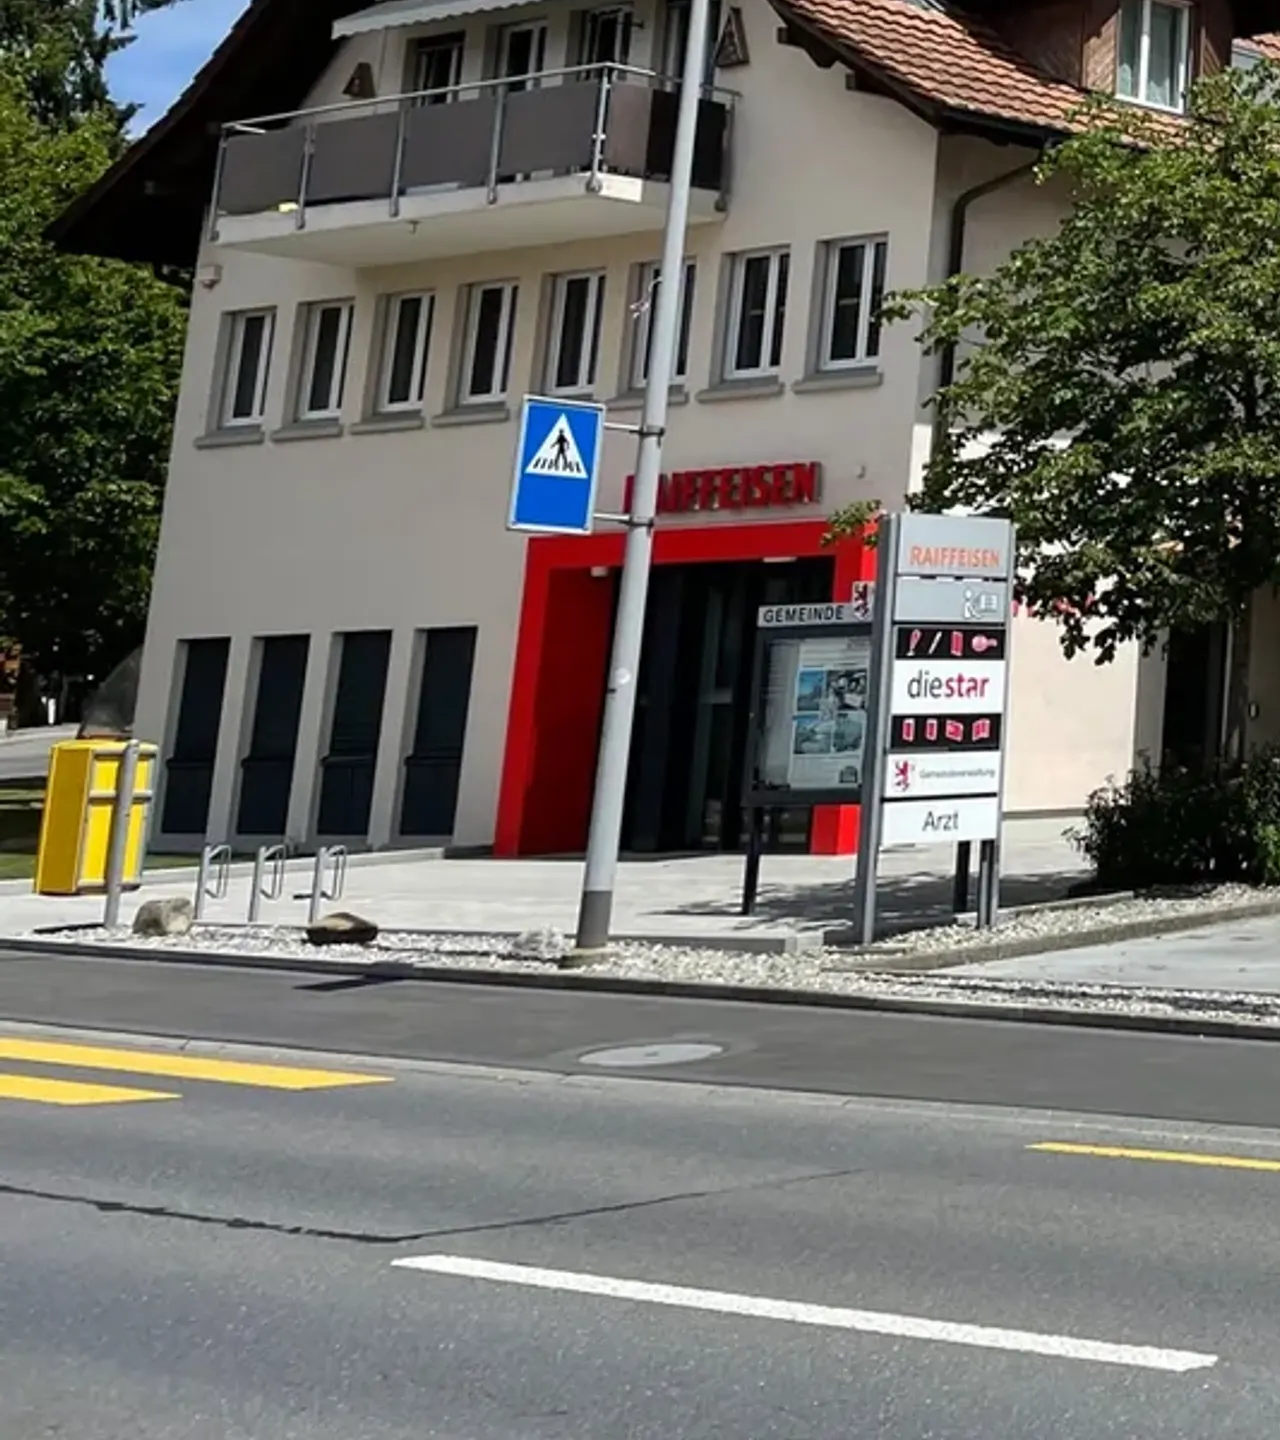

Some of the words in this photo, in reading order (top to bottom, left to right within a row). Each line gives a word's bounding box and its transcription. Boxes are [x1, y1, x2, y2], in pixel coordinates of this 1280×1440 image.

[910, 546, 999, 568] RAIFFEISEN
[763, 604, 845, 623] GEMEINDE
[907, 669, 990, 698] diestar
[922, 810, 959, 831] Arzt
